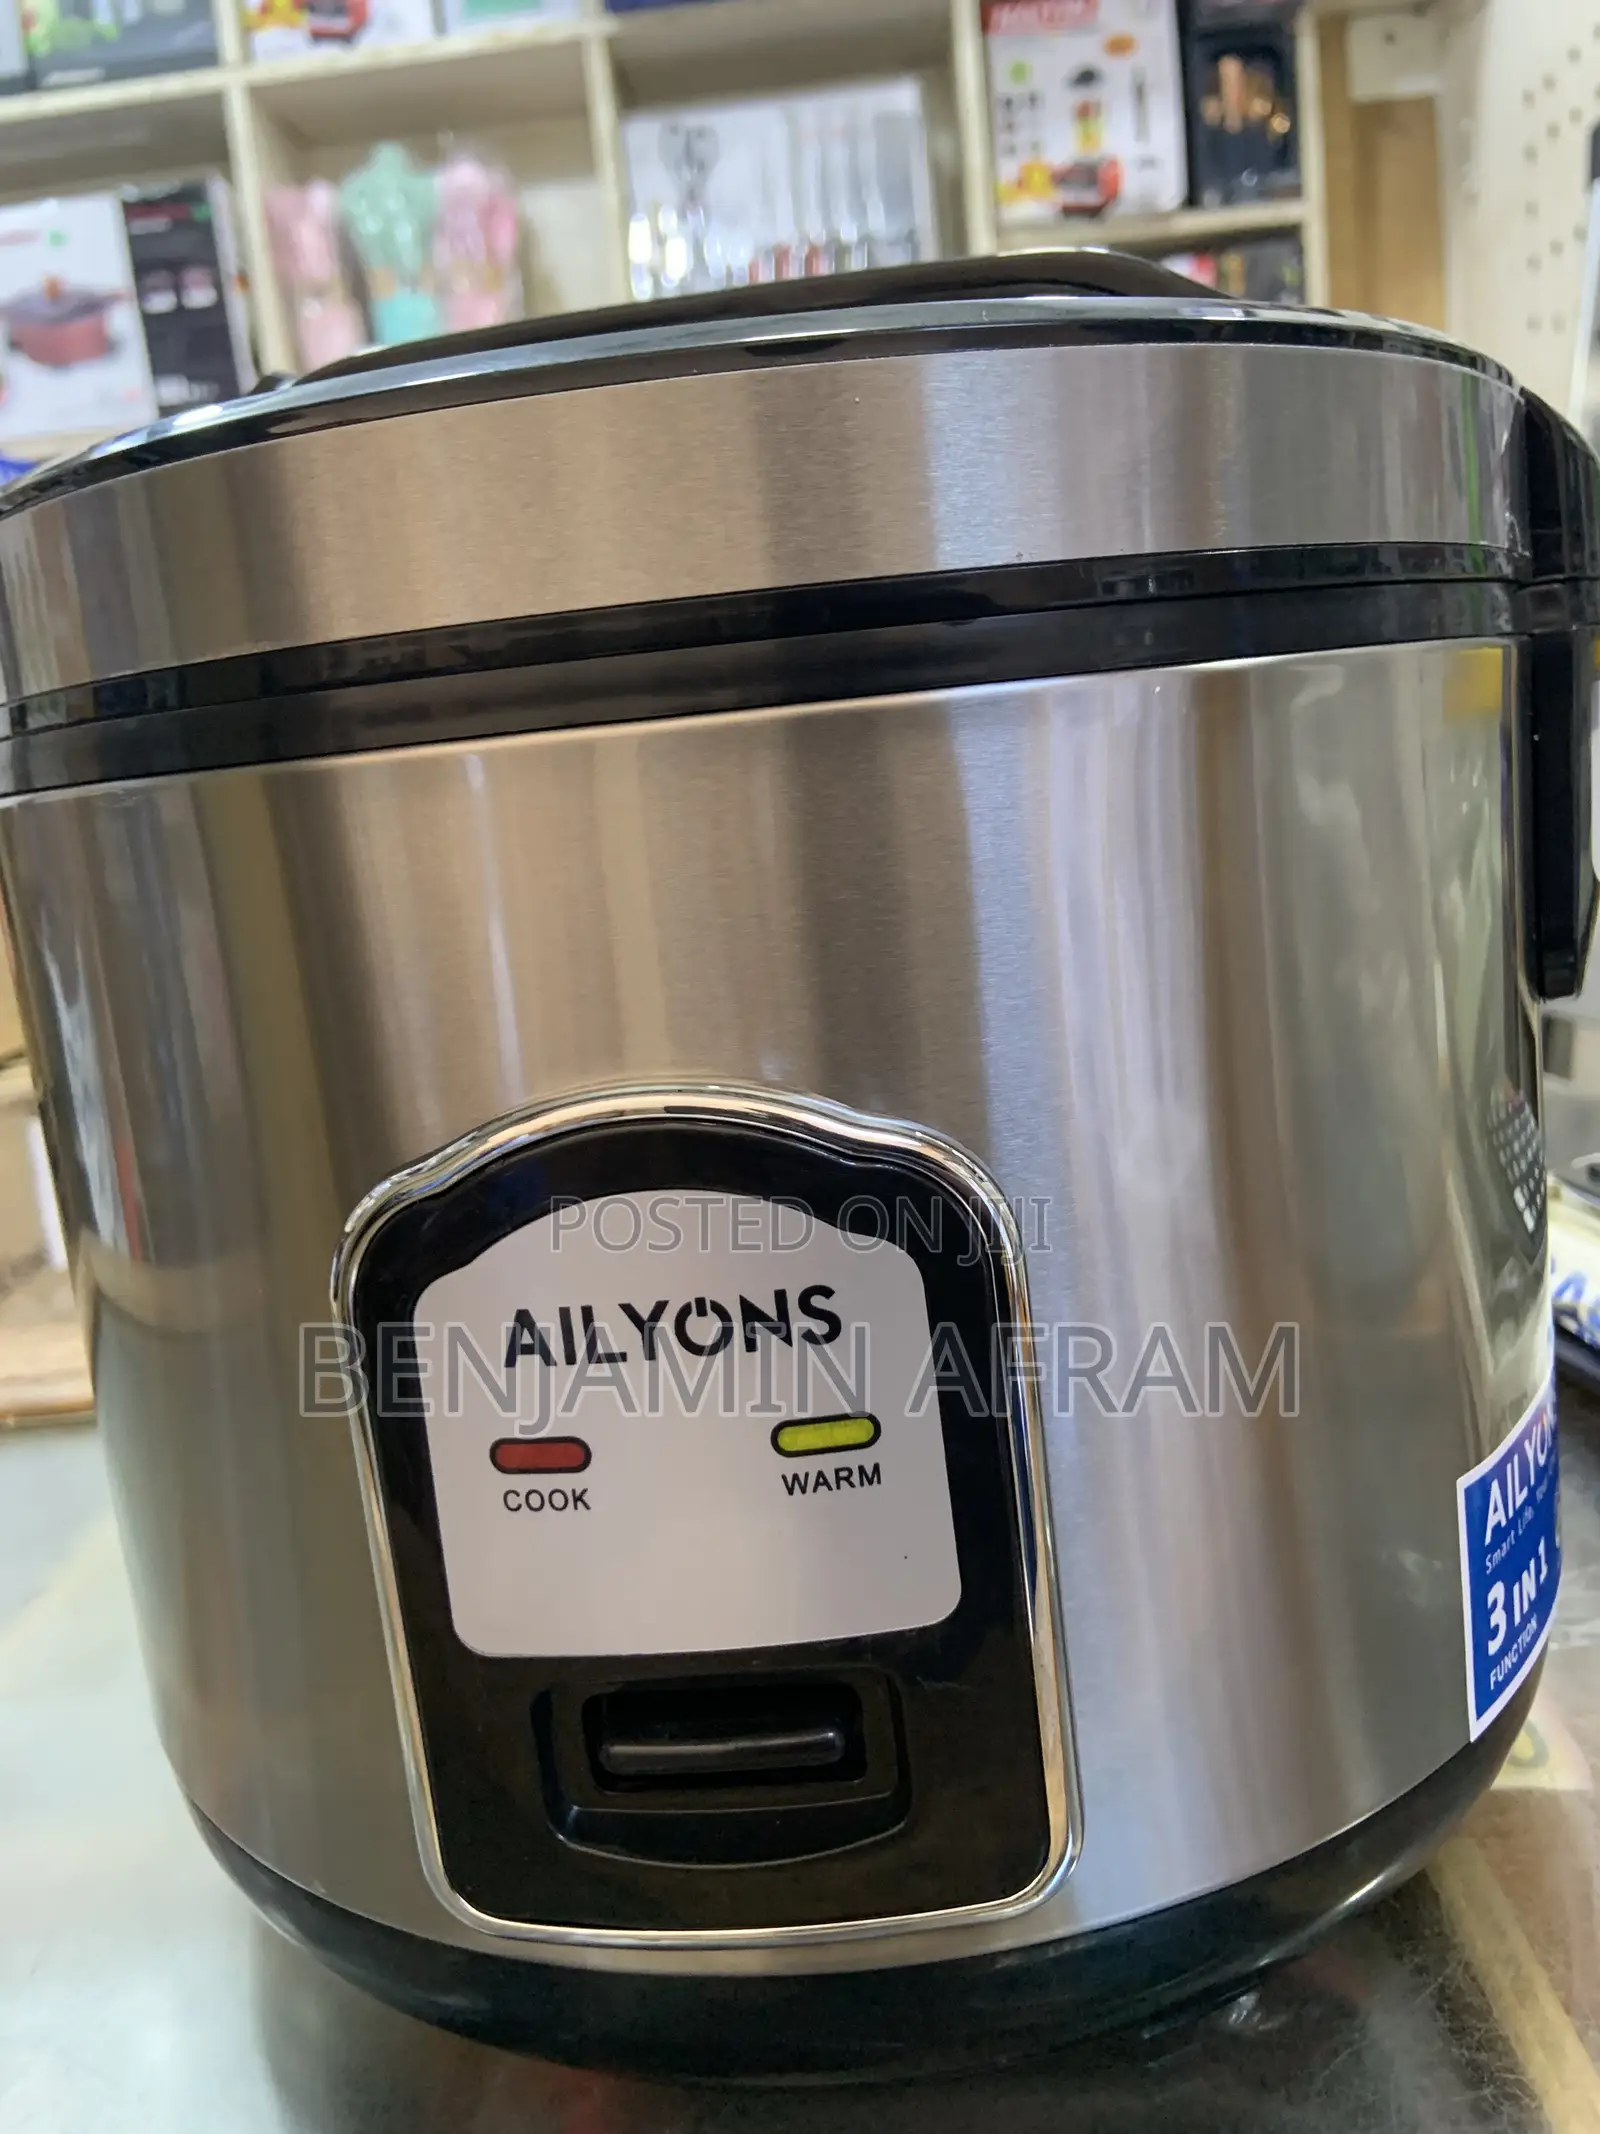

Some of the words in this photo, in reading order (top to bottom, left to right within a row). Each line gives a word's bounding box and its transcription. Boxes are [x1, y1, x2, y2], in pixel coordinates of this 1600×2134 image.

[504, 1284, 842, 1368] AILYONS
[502, 1488, 592, 1512] COOK
[781, 1462, 882, 1496] WARM
[1484, 1402, 1557, 1547] AILYON
[1485, 1529, 1516, 1575] Smart
[1487, 1580, 1507, 1656] 3
[1513, 1557, 1537, 1627] IN
[1538, 1535, 1549, 1585] 1
[1489, 1612, 1538, 1691] FUNCTION
